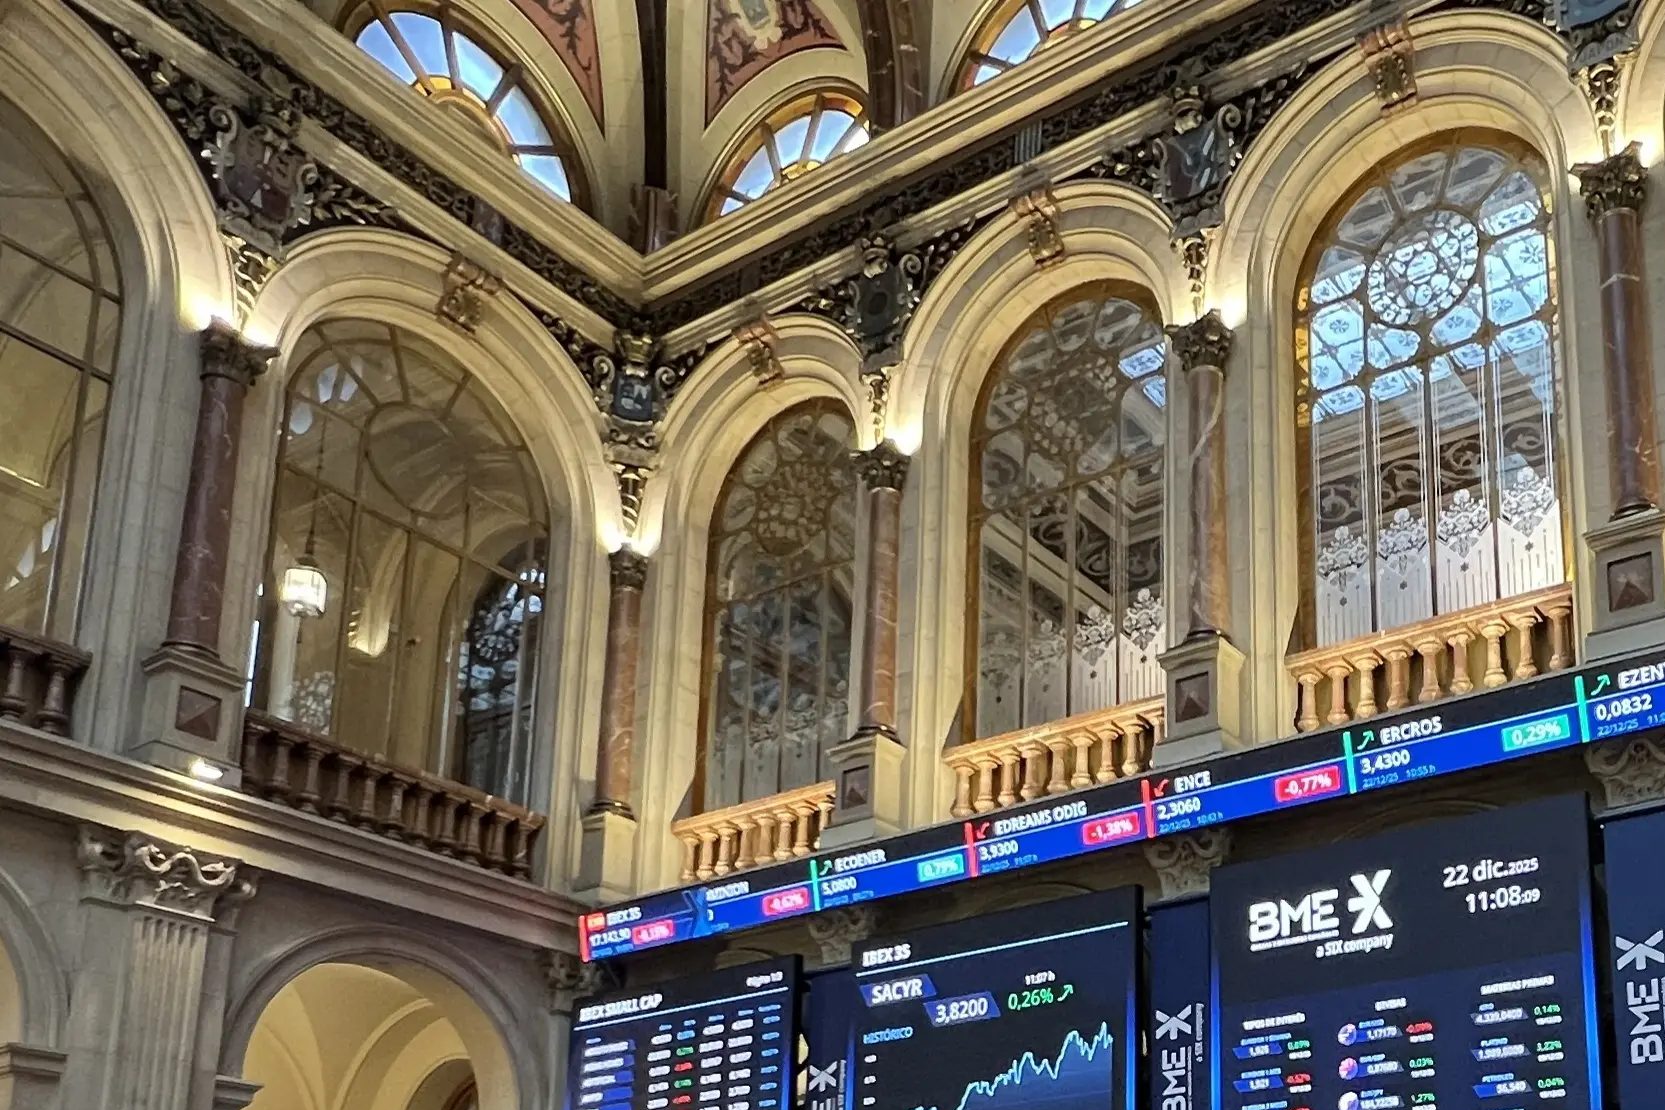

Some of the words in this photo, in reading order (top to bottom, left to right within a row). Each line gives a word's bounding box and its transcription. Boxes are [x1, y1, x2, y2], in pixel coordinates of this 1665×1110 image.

[1594, 694, 1653, 721] 0,0832
[1380, 716, 1442, 744] ERCROS
[1512, 722, 1561, 746] 0,29%
[1360, 749, 1410, 774] 3,4300
[1174, 771, 1211, 793] ENCE
[1284, 773, 1332, 796] -0,77%
[994, 810, 1050, 836] EDREAMS
[1053, 801, 1087, 821] ODIG
[1156, 797, 1200, 820] 2,3060
[834, 849, 886, 873] ECOENER
[980, 840, 1018, 861] 3,9300
[1443, 865, 1470, 888] 22
[1465, 886, 1541, 914] 11:08:09
[1250, 888, 1339, 942] BME
[862, 947, 893, 968] IBEX
[894, 944, 911, 962] 35
[1325, 940, 1343, 956] SIX
[1343, 934, 1393, 953] company
[872, 979, 922, 1004] SACYR
[935, 998, 988, 1023] 3,8200
[1008, 988, 1053, 1011] 0,26%
[1626, 978, 1664, 1064] BME
